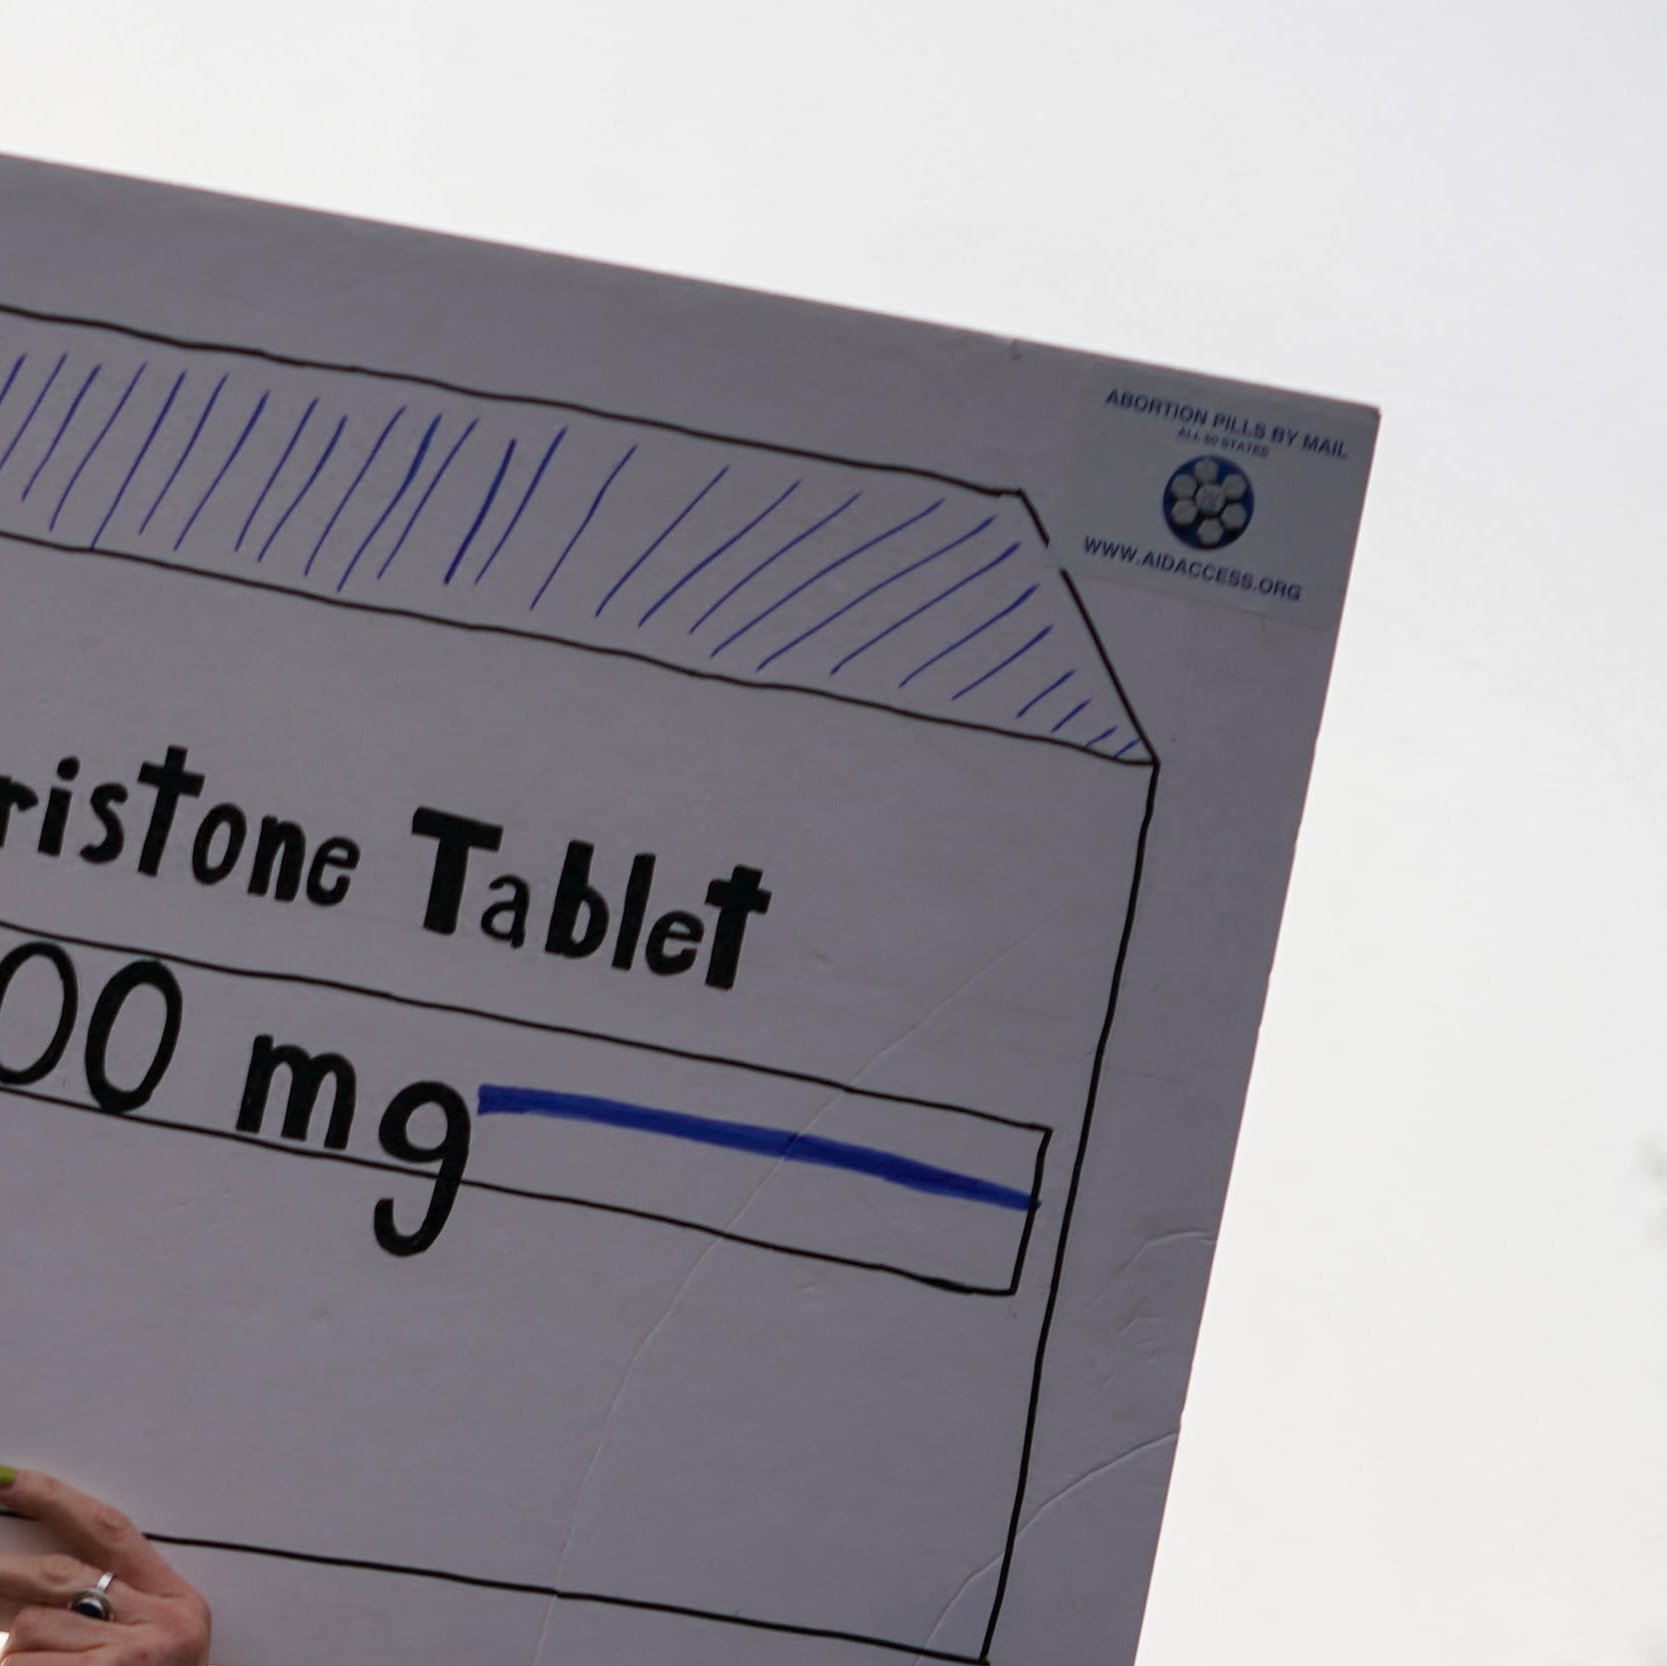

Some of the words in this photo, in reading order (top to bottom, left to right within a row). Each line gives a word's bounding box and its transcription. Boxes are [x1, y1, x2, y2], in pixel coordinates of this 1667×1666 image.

[1105, 389, 1209, 425] ABORTION
[1212, 413, 1267, 439] PILLS
[1271, 425, 1299, 447] BY
[1301, 433, 1348, 459] MAIL
[1083, 536, 1302, 602] WWW.AIDACCESS.ORG
[410, 805, 773, 992] Tablet
[233, 1033, 474, 1258] mg
